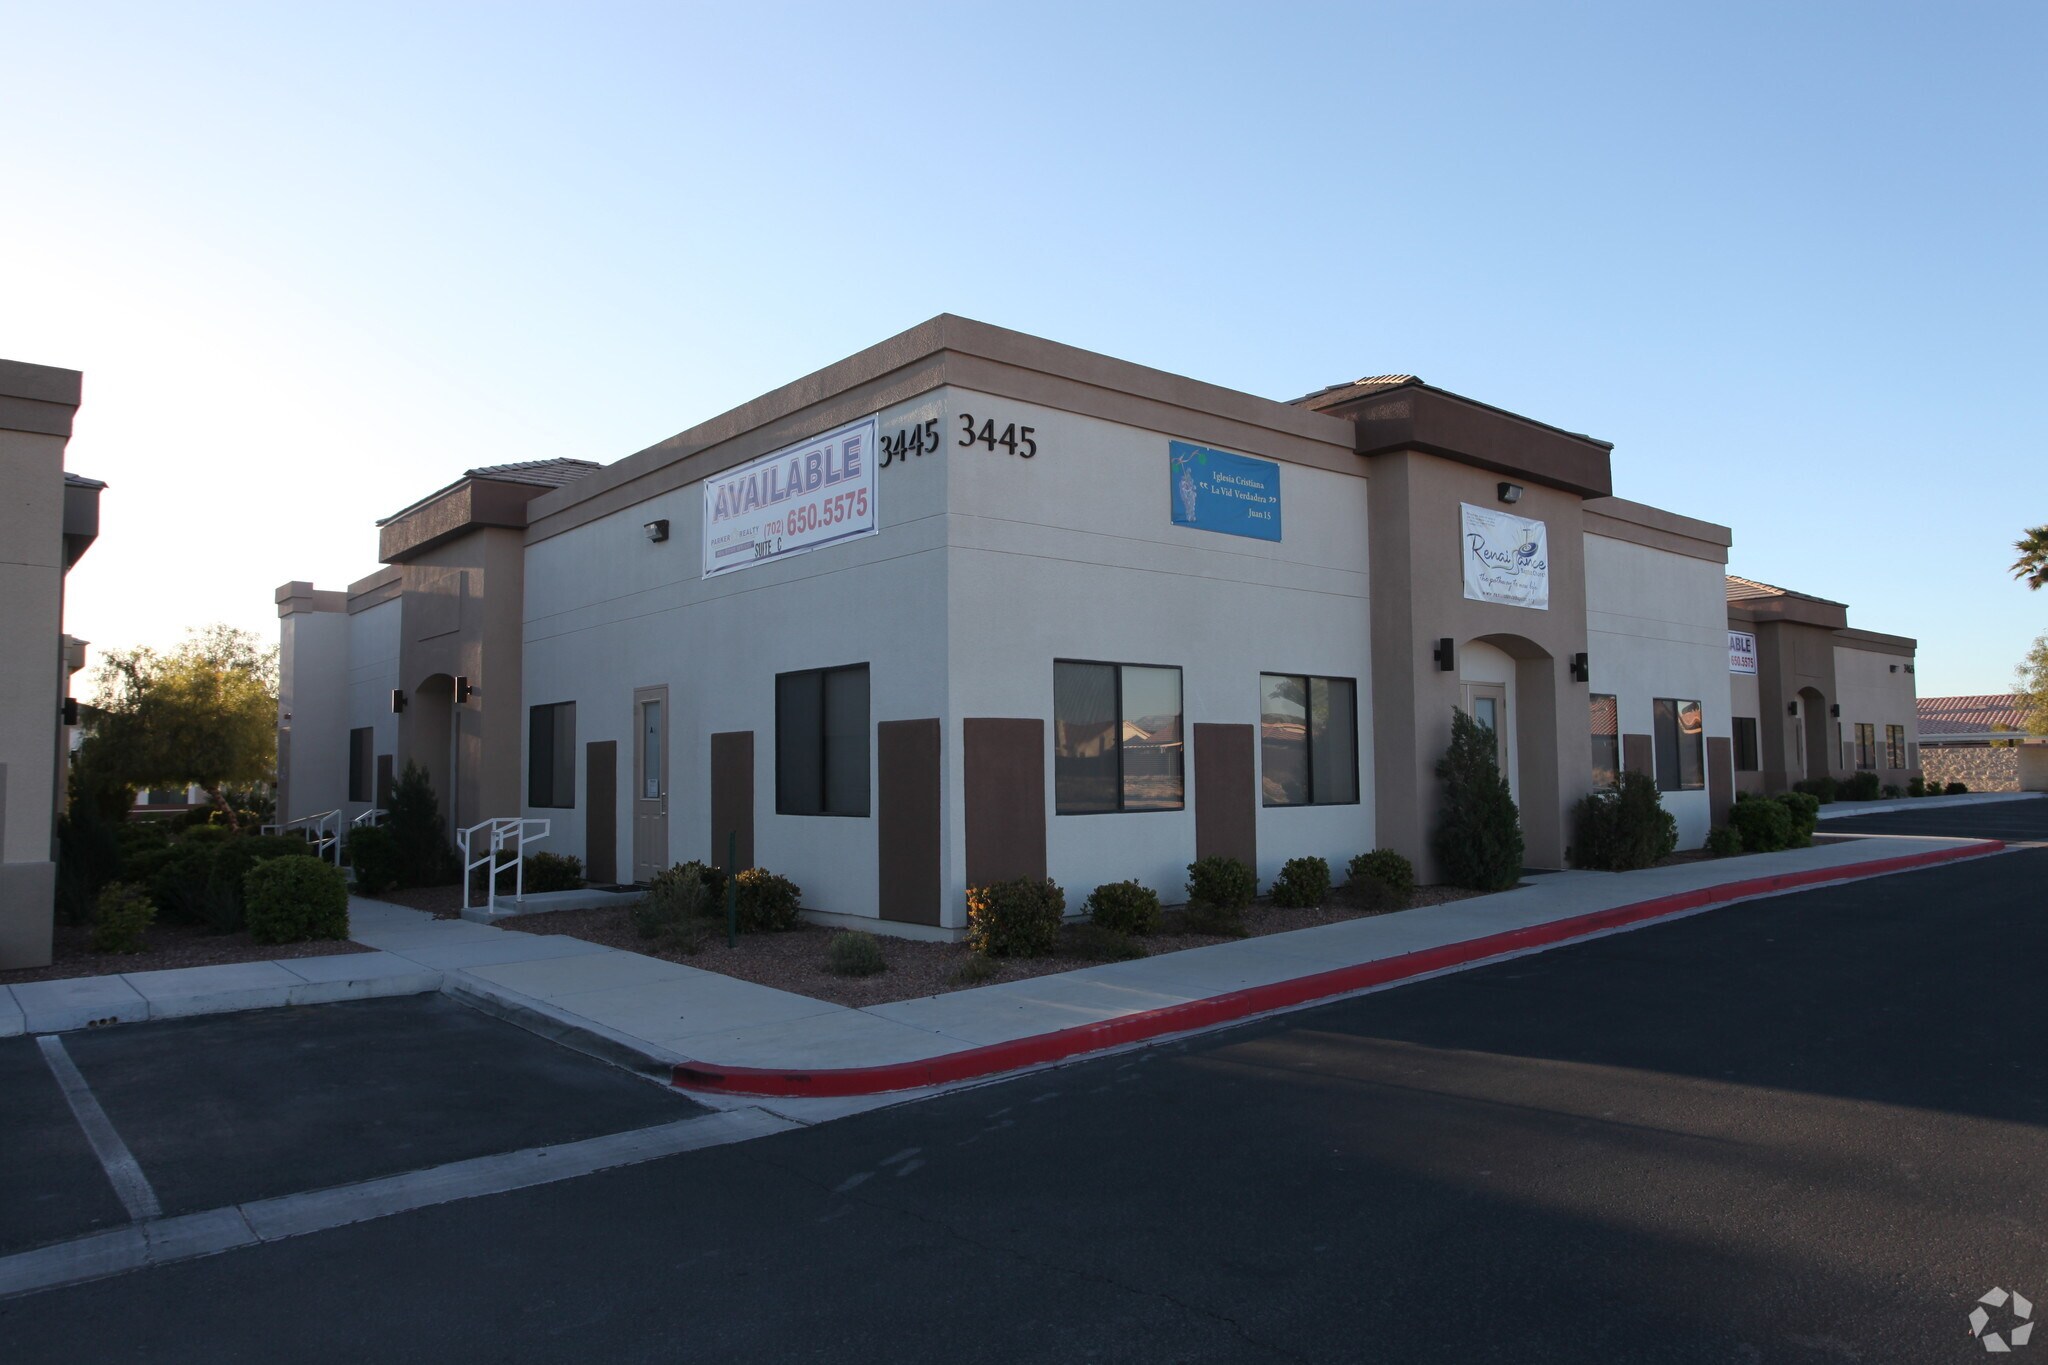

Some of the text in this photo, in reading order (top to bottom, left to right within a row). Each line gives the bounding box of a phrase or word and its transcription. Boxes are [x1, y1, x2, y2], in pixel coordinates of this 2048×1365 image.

[879, 418, 939, 468] 3445
[958, 413, 1037, 458] 3445
[712, 434, 862, 525] AVAILABLE
[1213, 471, 1265, 489] Iglesia Cristiana
[1211, 485, 1220, 495] La
[1221, 486, 1233, 497] Vid
[1234, 489, 1267, 504] Verdadera
[763, 487, 868, 540] (702) 650.5575
[1248, 508, 1272, 520] Juan 15
[710, 526, 760, 546] PARKER REALTY
[754, 539, 772, 558] SUITE
[777, 536, 782, 552] C
